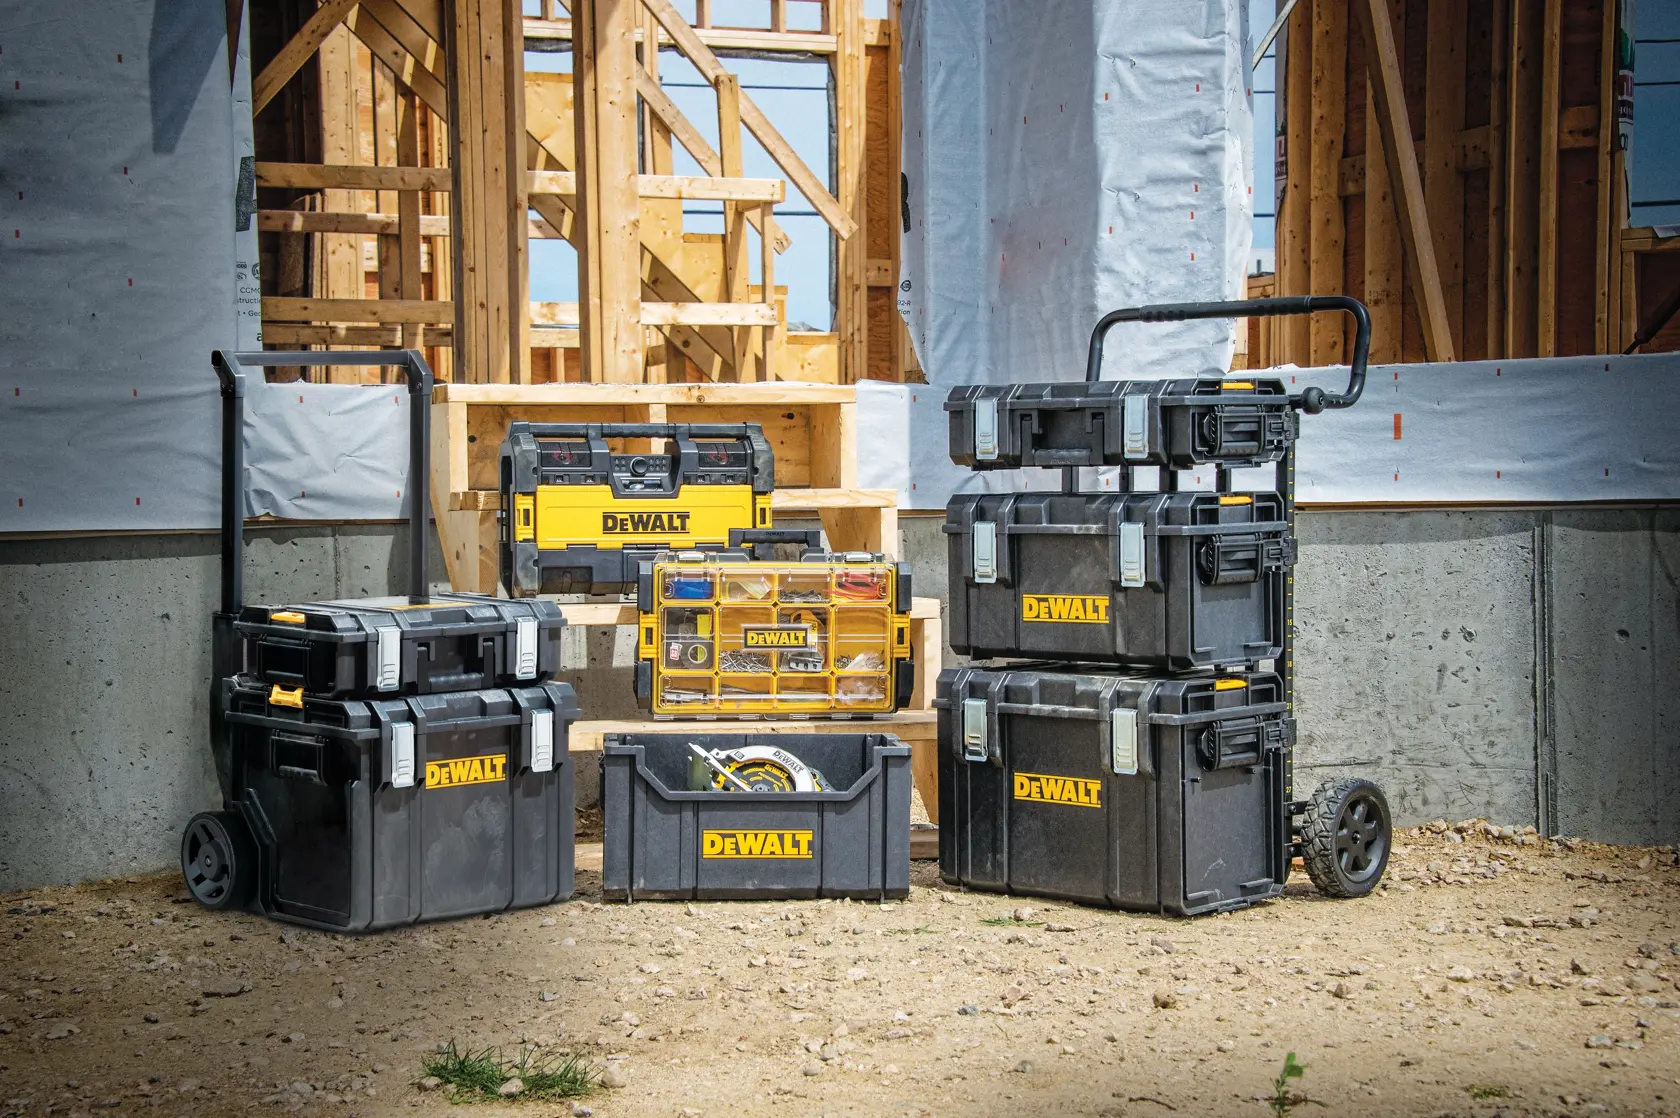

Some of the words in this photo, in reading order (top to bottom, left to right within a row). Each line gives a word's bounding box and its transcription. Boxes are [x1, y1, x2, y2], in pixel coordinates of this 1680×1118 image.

[602, 514, 690, 532] DEWALT
[1023, 597, 1109, 620] DEWALT
[747, 631, 806, 645] DEWALT
[426, 757, 506, 786] DEWALT
[1014, 775, 1101, 804] DEWALT
[703, 833, 813, 855] DEWALT
